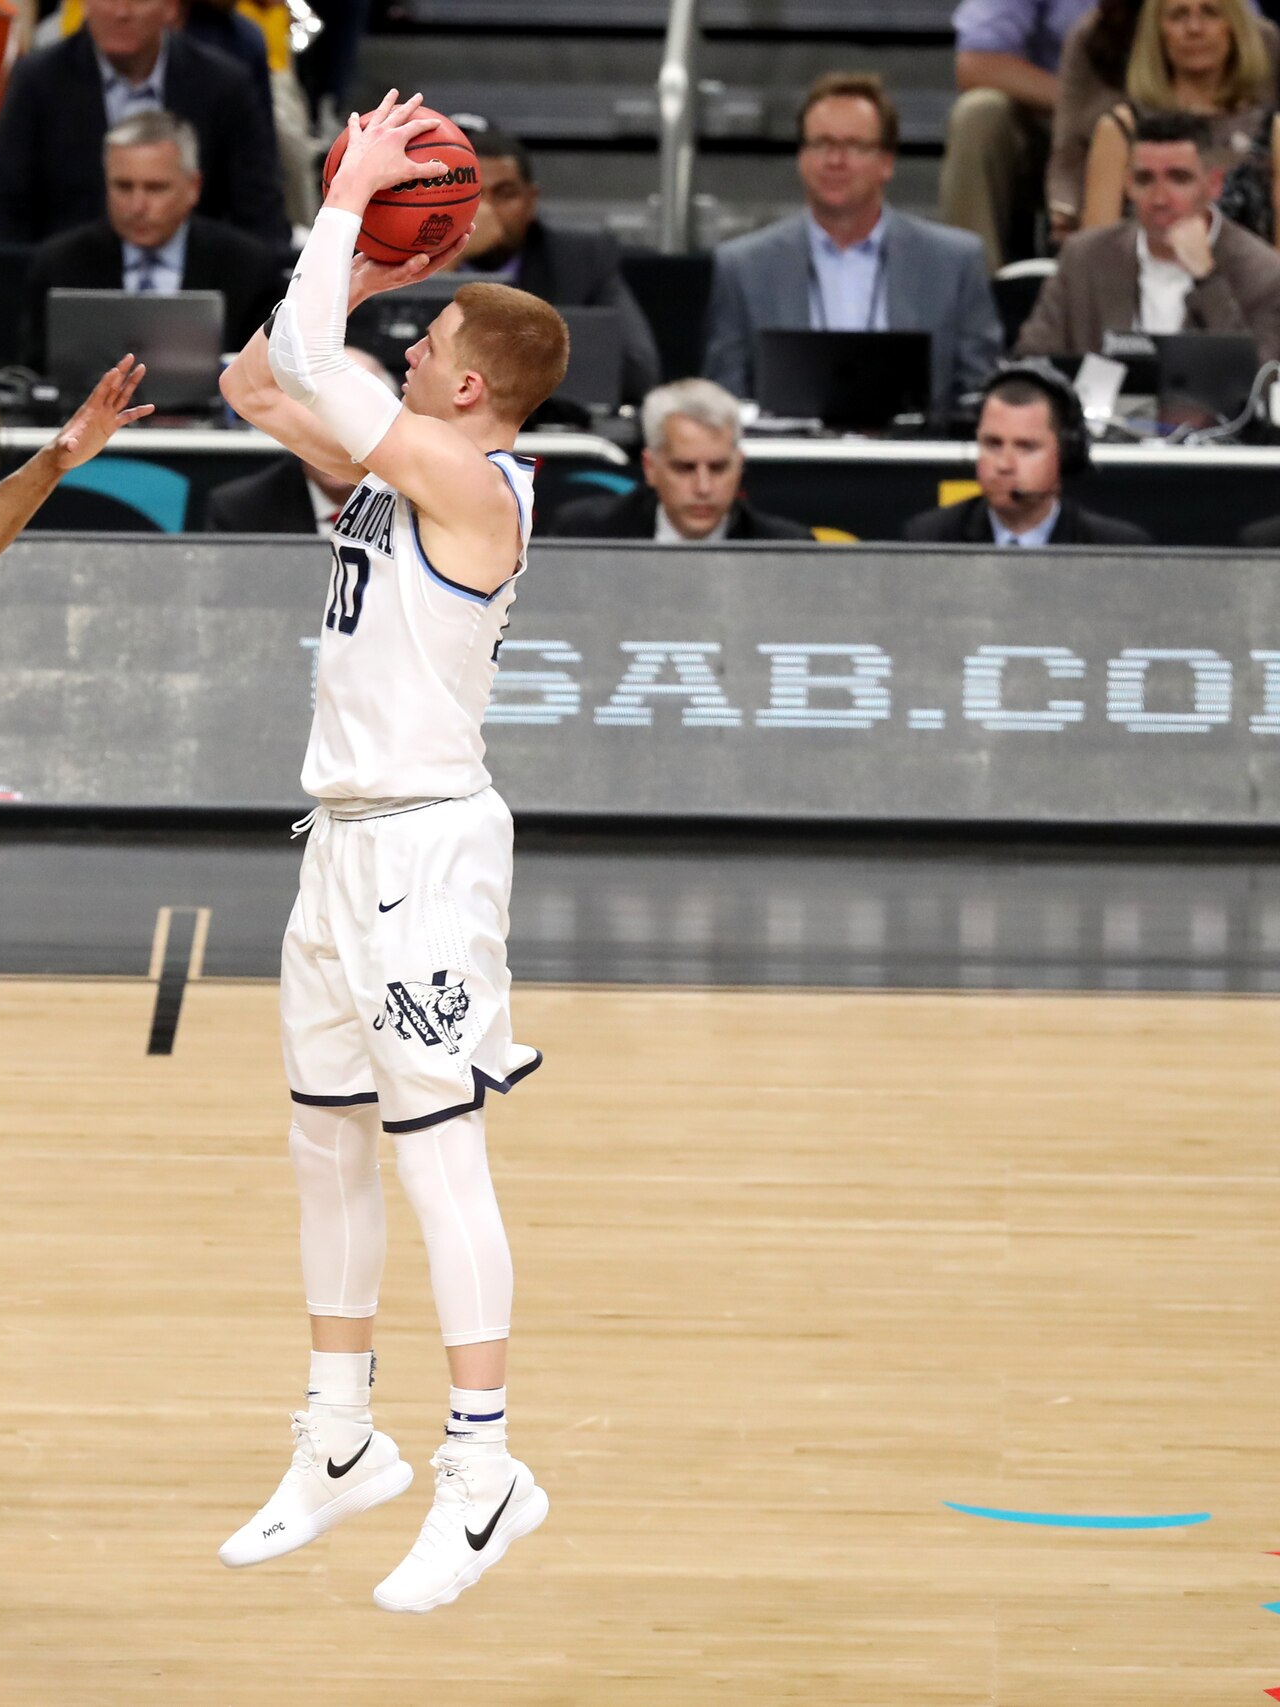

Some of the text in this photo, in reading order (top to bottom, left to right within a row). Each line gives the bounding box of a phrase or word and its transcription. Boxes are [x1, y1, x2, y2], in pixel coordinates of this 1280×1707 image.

[300, 637, 1280, 734] SAB.CO
[394, 988, 436, 1041] VILLANOVA
[262, 1522, 286, 1539] MPC
